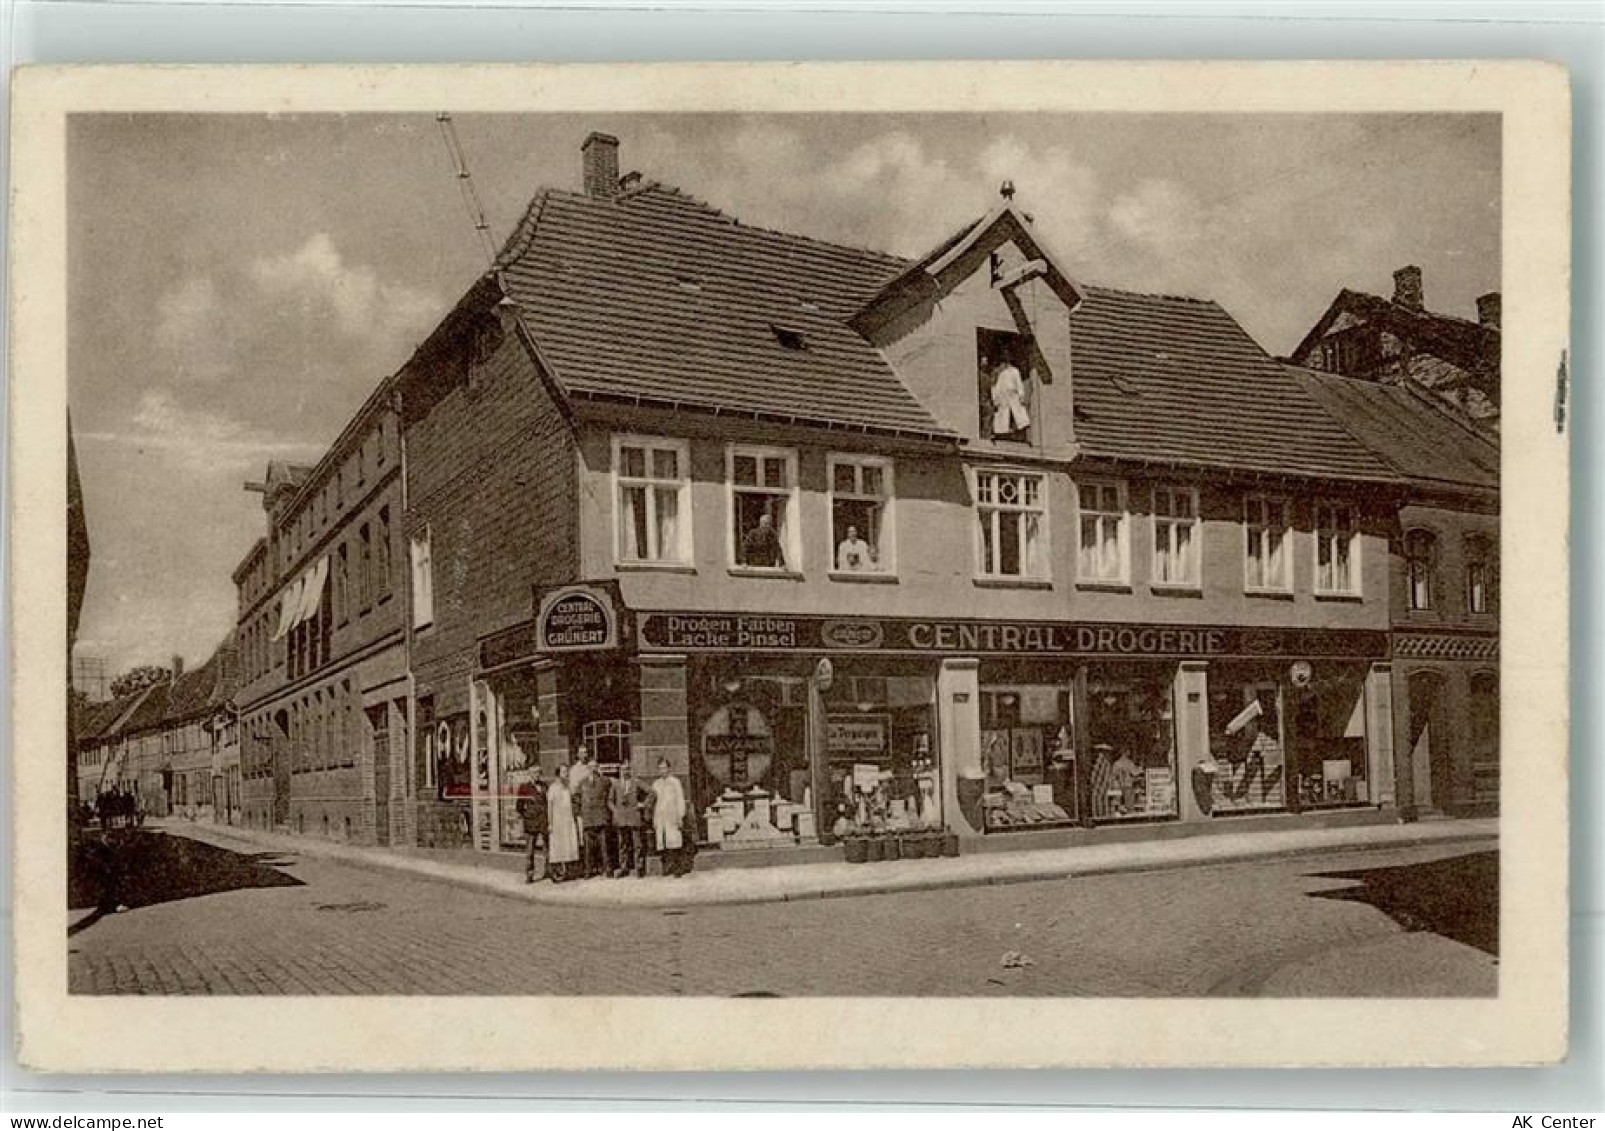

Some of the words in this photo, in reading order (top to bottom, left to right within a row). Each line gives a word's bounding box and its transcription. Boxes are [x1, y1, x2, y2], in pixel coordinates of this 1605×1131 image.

[668, 616, 731, 632] Drogen
[737, 618, 796, 634] Farben
[737, 633, 796, 646] Pinsel
[1076, 627, 1224, 652] DROGERIE
